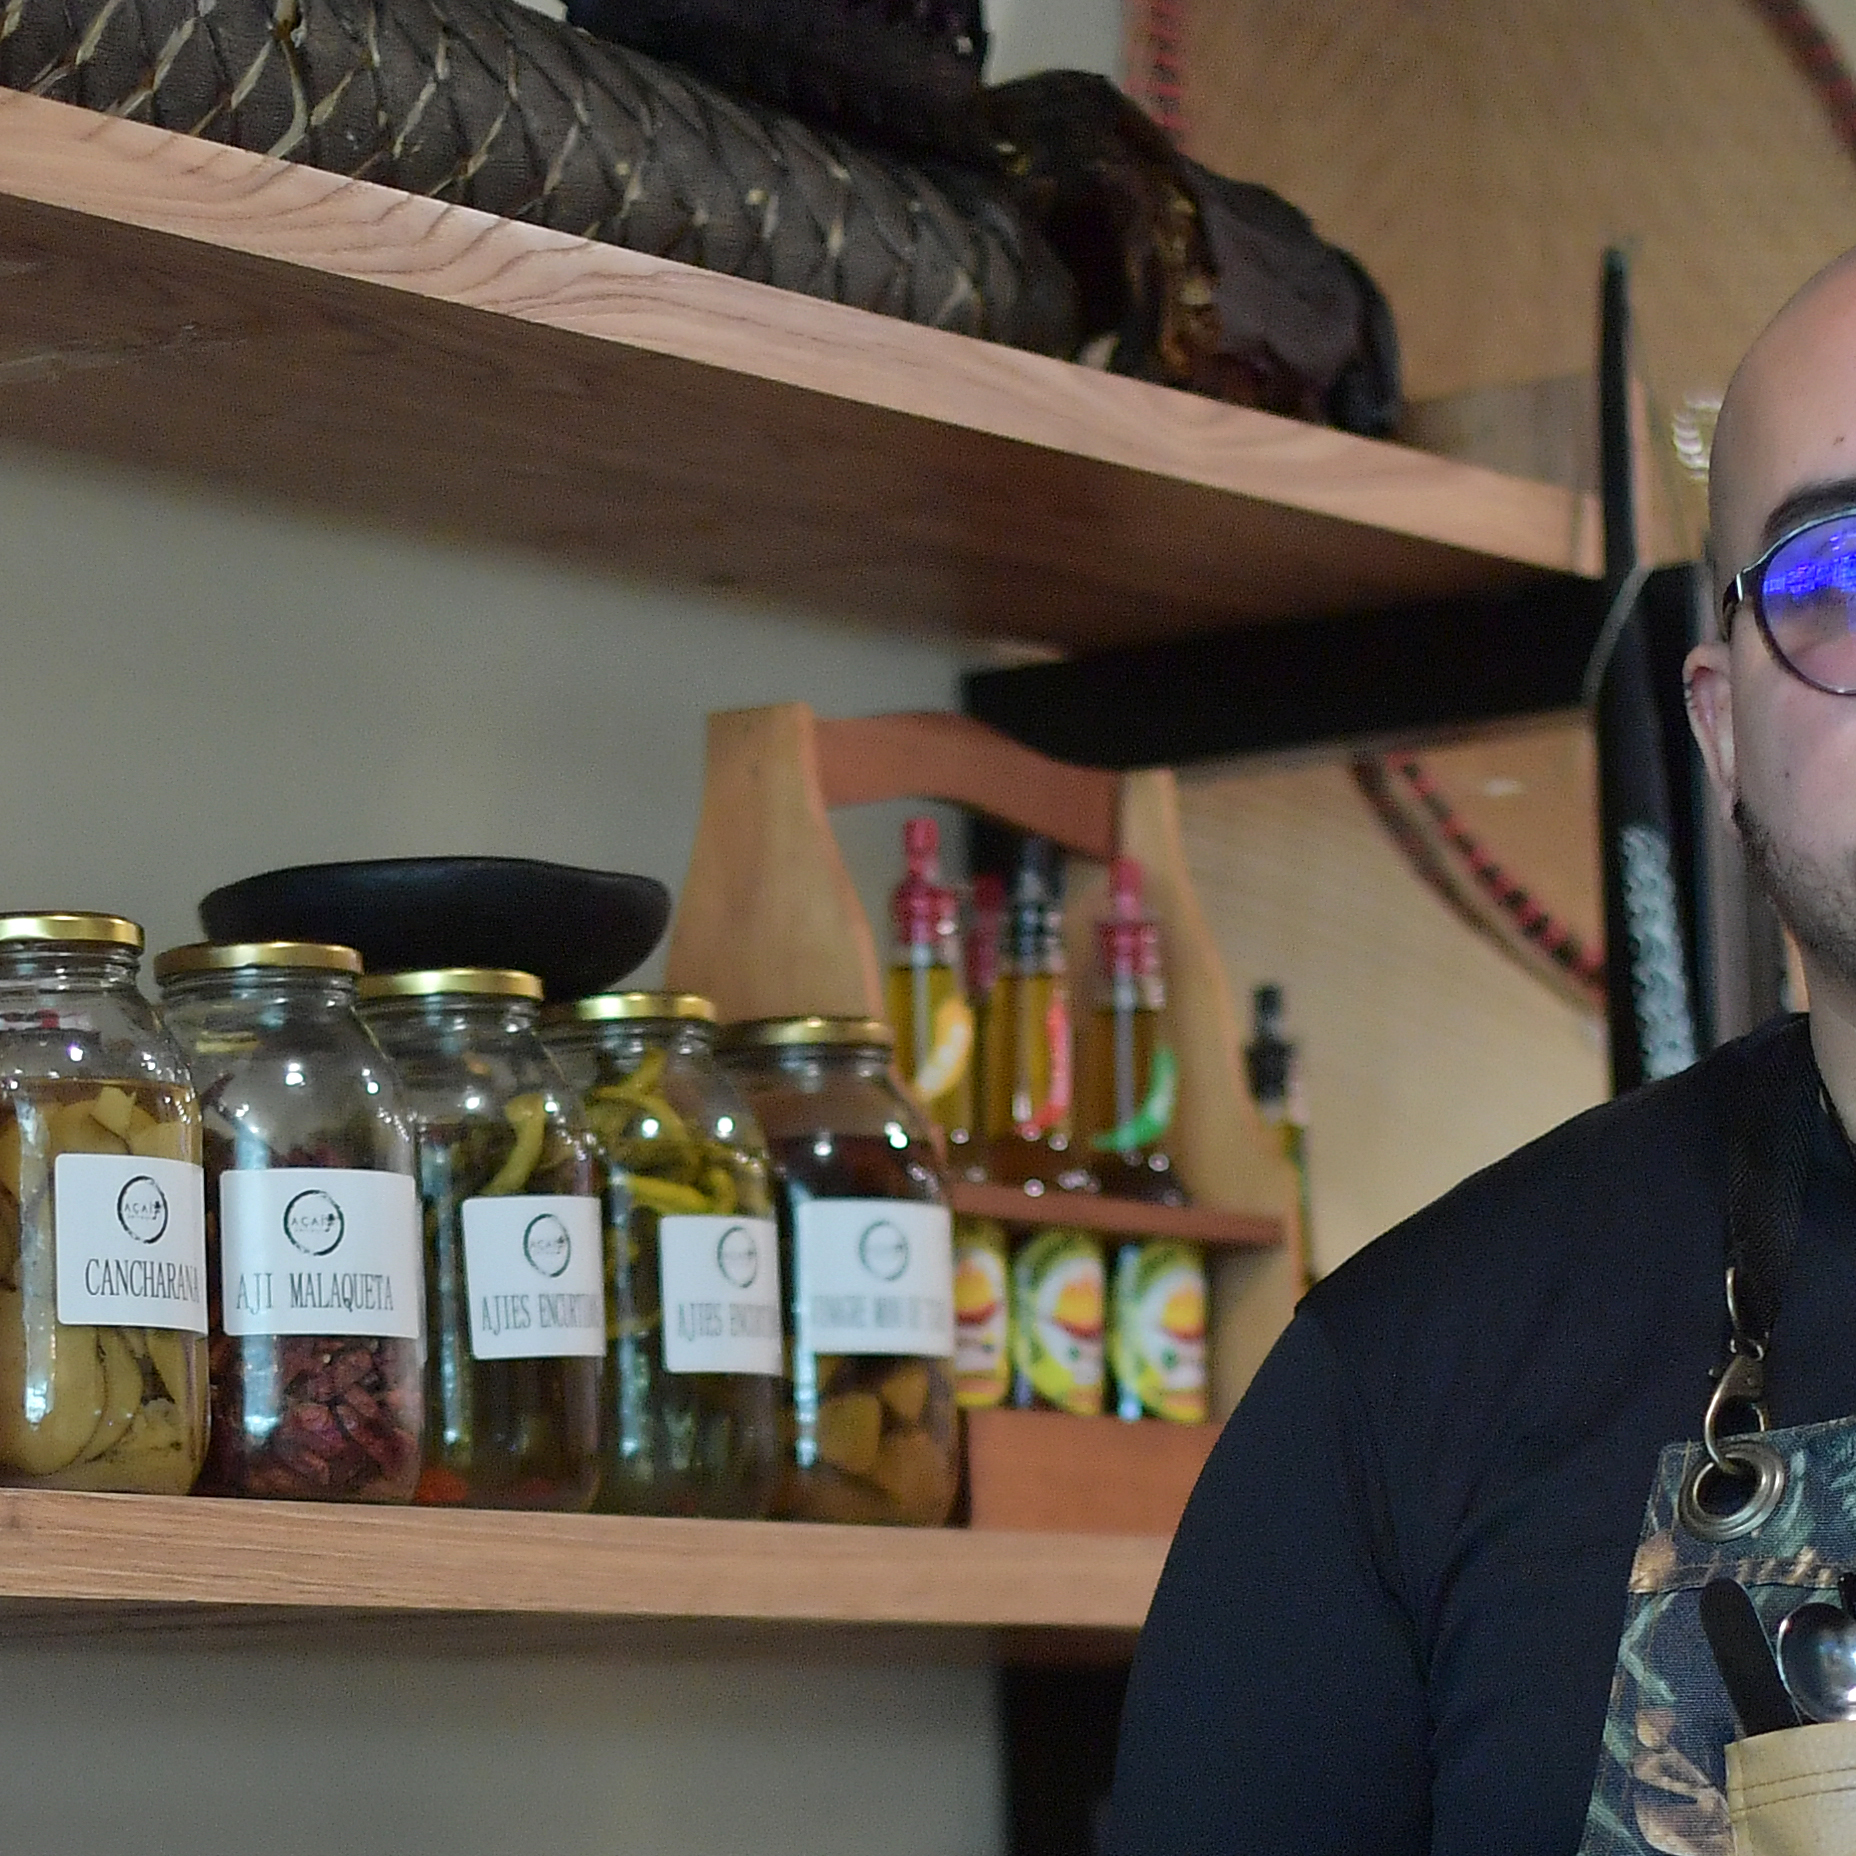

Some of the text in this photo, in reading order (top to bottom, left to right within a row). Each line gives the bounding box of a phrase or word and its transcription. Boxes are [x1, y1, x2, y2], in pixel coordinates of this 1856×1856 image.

[235, 1272, 394, 1316] AJI MALAQUETA
[481, 1293, 532, 1337] AJIES
